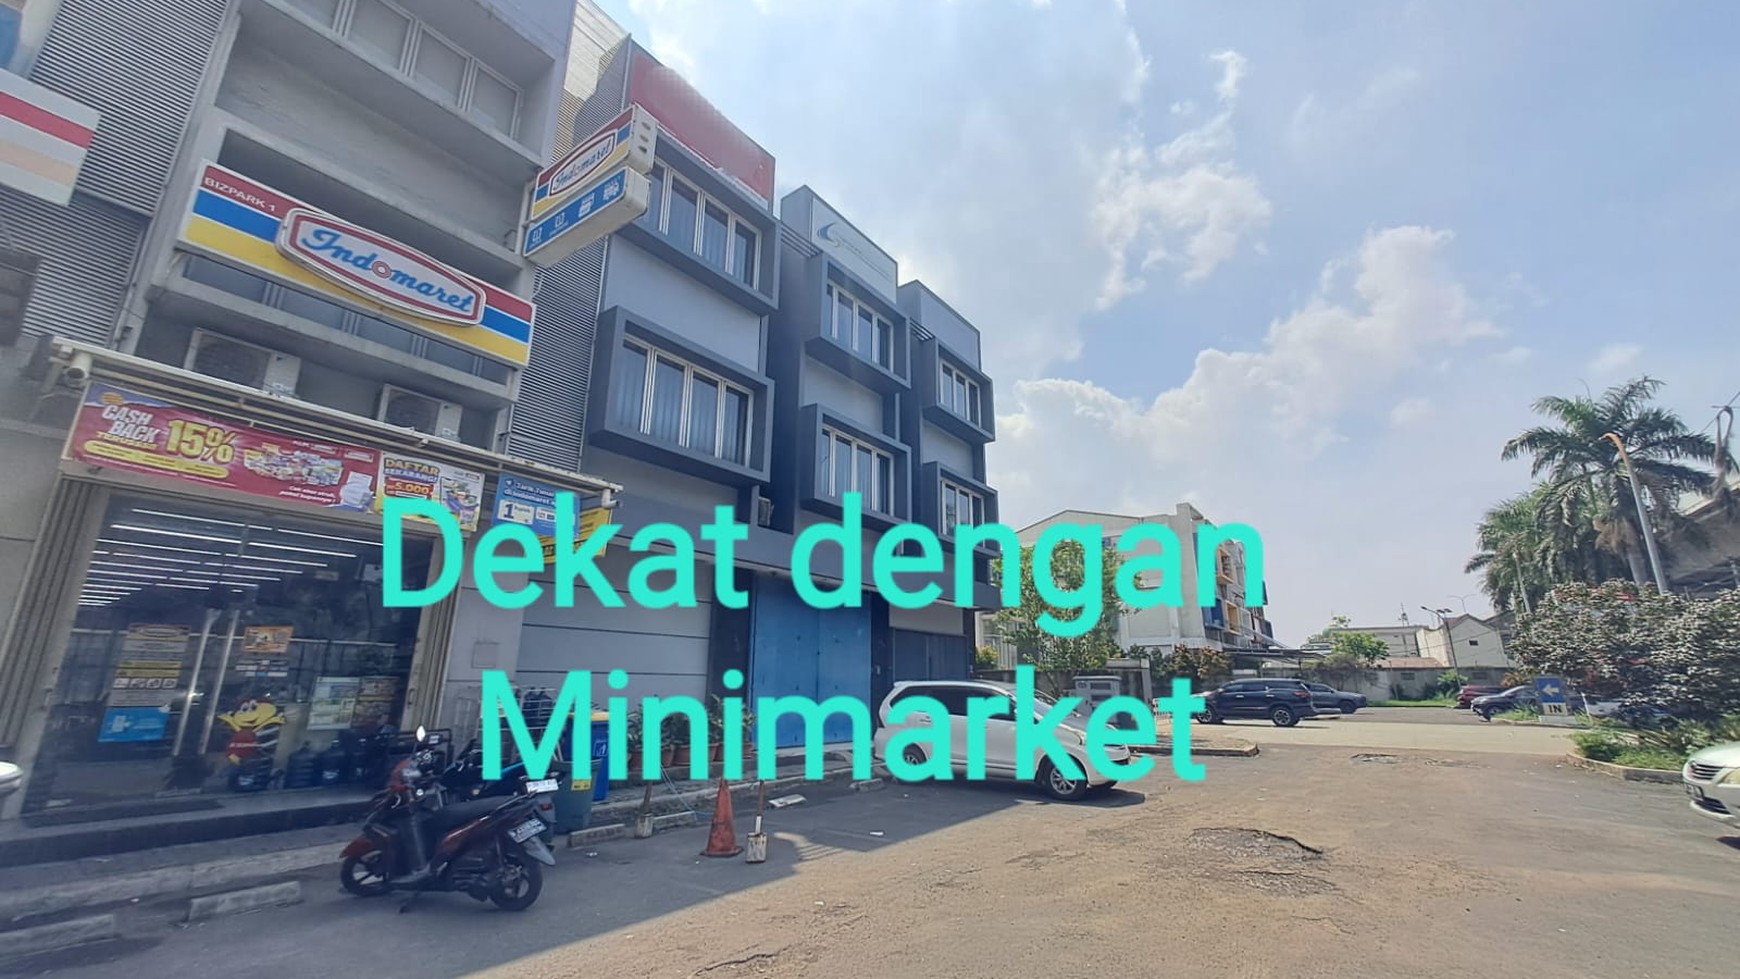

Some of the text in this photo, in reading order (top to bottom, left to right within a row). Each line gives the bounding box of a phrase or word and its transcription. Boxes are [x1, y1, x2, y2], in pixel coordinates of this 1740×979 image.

[204, 176, 277, 213] BIZPARK 1
[301, 228, 476, 313] Indomaret
[102, 404, 154, 426] CASH
[109, 420, 162, 443] BACK
[165, 418, 238, 465] 15%
[385, 458, 440, 476] DAFTAR
[503, 503, 514, 519] 1
[1549, 703, 1563, 714] IN
